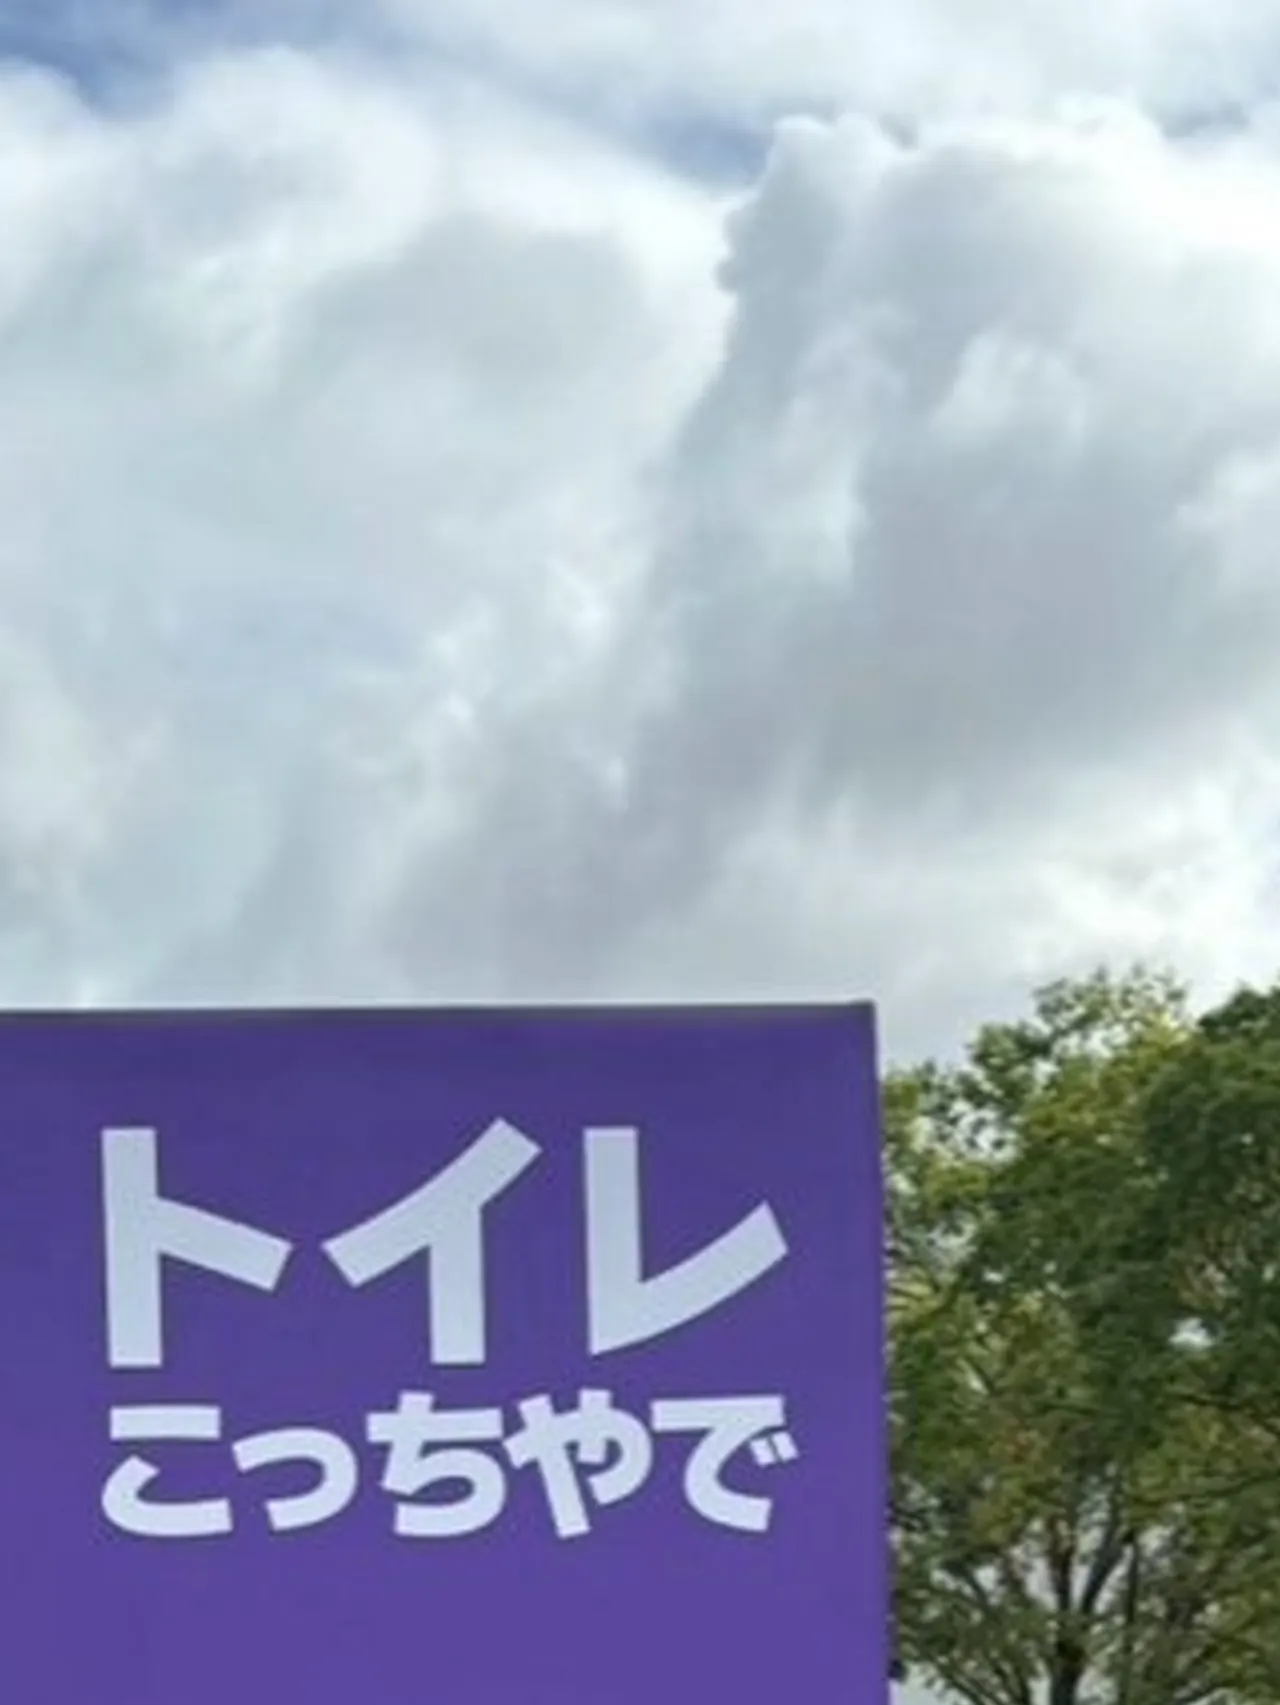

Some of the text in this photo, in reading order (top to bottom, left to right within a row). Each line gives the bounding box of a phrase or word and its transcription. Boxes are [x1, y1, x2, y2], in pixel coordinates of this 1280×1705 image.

[102, 1117, 789, 1368] トイレ
[102, 1388, 799, 1538] こっちやで
